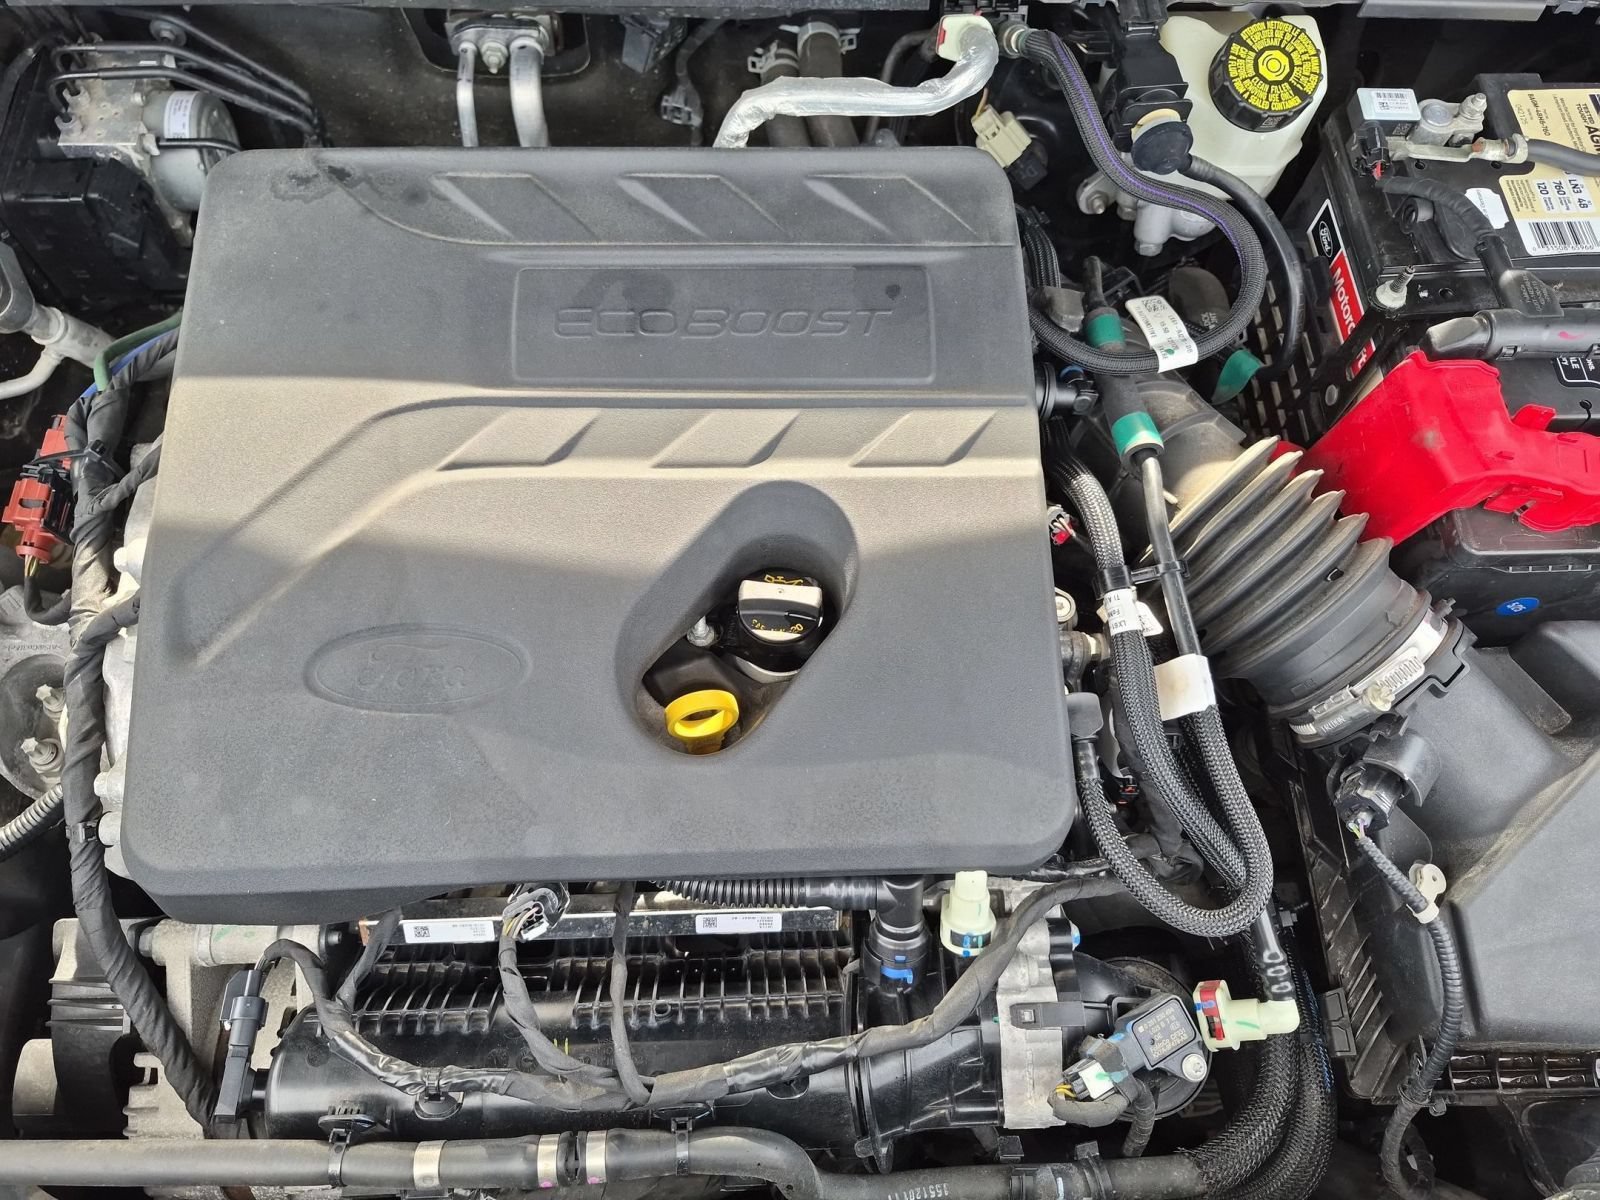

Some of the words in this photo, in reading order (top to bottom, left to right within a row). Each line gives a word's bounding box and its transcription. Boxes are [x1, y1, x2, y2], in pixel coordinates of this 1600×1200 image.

[1229, 42, 1241, 56] DOT
[1237, 46, 1249, 58] CAP
[1239, 20, 1266, 41] ATTENTION
[1265, 20, 1295, 33] NETTOYER
[1291, 27, 1301, 37] LE
[1297, 31, 1317, 56] BOUCHON
[1310, 55, 1320, 73] AVANT
[1250, 28, 1274, 44] EMPLOYER
[1275, 29, 1286, 39] QUE
[1301, 53, 1310, 61] DE
[1228, 60, 1239, 78] FLUID
[1236, 59, 1248, 81] BEFORE
[1245, 49, 1257, 78] WARNING
[1231, 77, 1247, 95] FROM
[1241, 78, 1268, 101] REMOVING
[1250, 76, 1270, 93] CLEAN
[1270, 81, 1291, 94] FILLER
[1242, 91, 1250, 99] A
[1248, 94, 1269, 109] SEALED
[1268, 93, 1280, 102] USE
[1271, 94, 1303, 112] CONTAINER
[1280, 89, 1295, 102] ONLY
[1580, 103, 1596, 124] TESTED
[1535, 182, 1550, 195] 120
[1551, 180, 1567, 196] 760
[1567, 179, 1583, 194] LN3
[1576, 198, 1589, 209] 48
[1318, 226, 1332, 253] Ford
